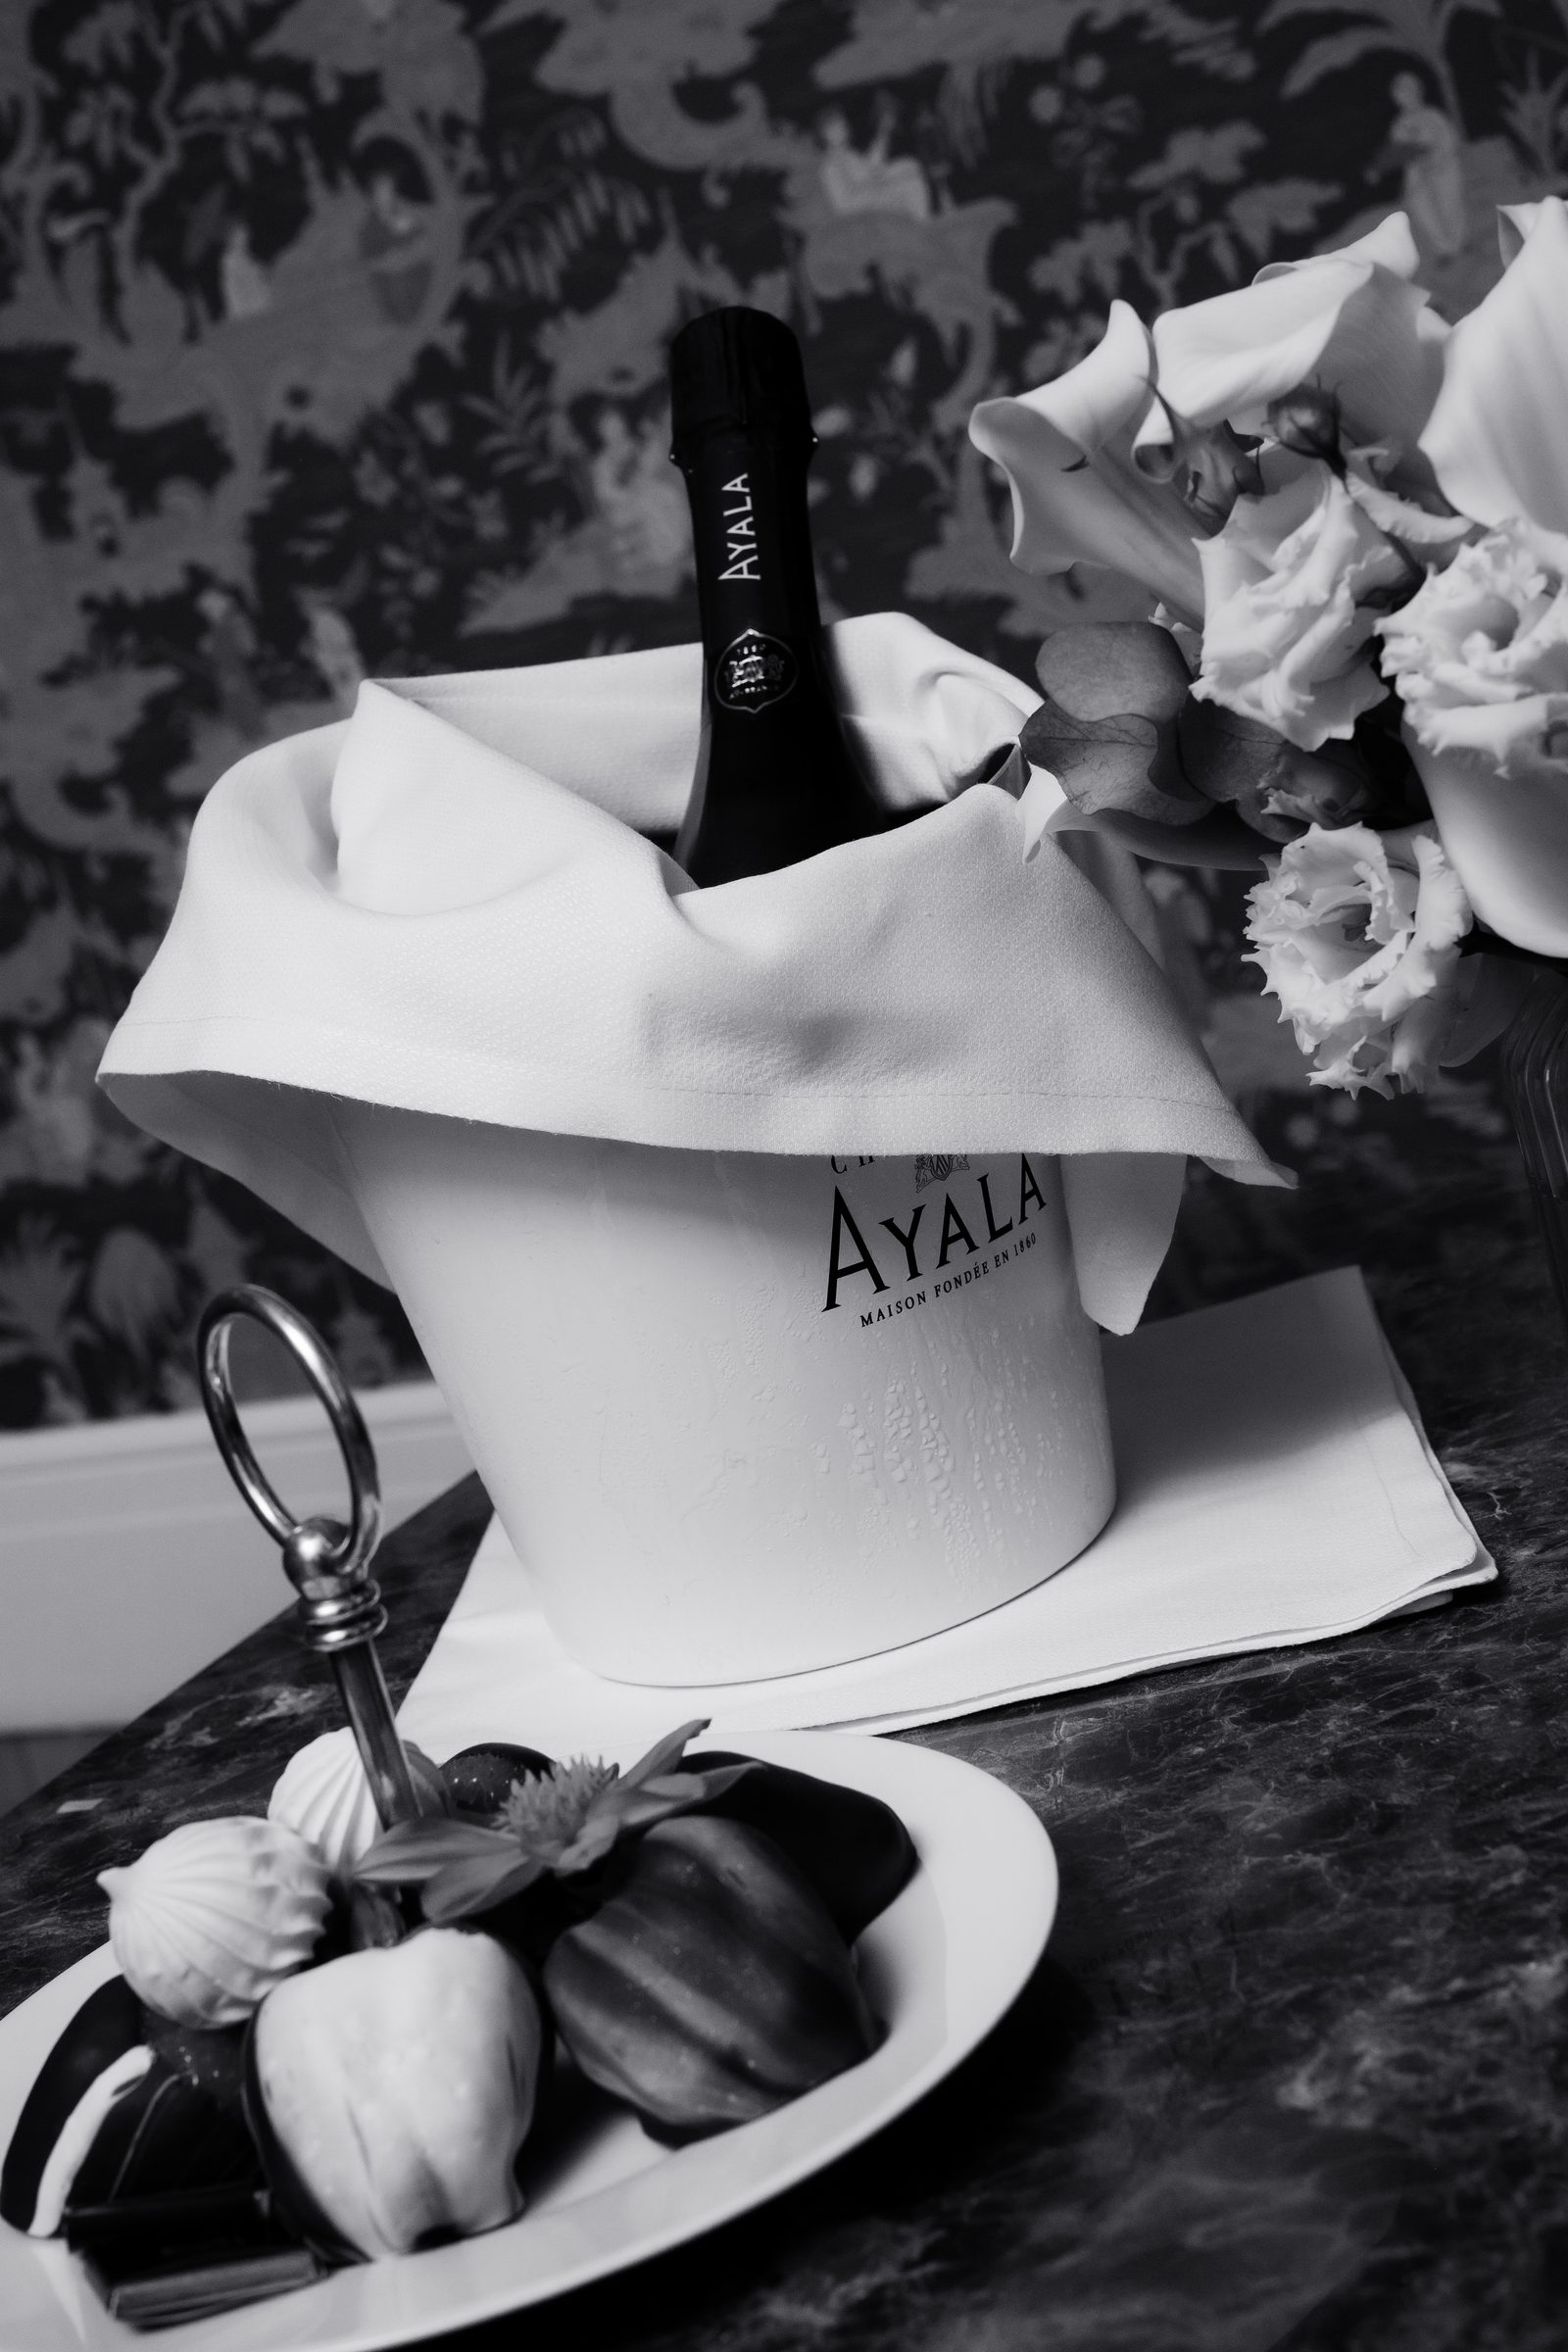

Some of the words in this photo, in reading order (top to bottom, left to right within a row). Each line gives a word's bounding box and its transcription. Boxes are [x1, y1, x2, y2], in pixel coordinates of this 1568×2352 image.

[717, 472, 760, 580] AYALA
[821, 1152, 1047, 1312] AYALA
[859, 1291, 926, 1327] MAISON
[933, 1261, 990, 1298] FONDÉE
[994, 1249, 1010, 1268] EN
[1013, 1232, 1037, 1256] 1860
